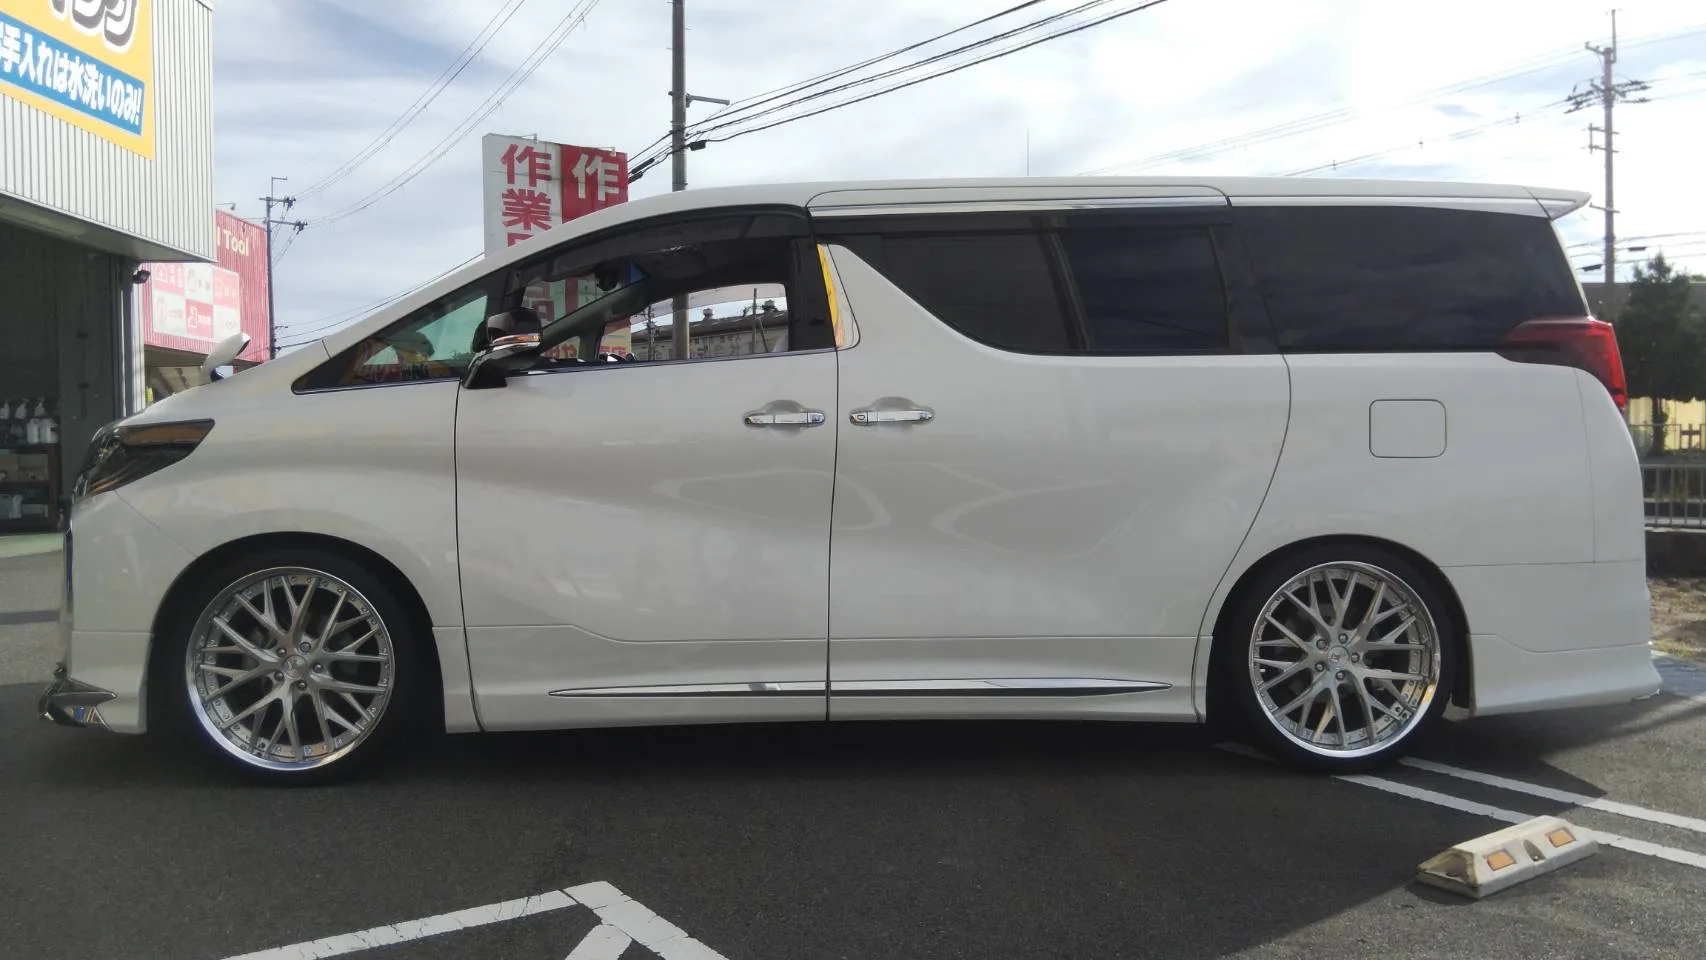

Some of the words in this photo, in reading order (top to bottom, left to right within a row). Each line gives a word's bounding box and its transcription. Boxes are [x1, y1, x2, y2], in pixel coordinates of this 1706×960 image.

[0, 21, 142, 126] 手入れは水洗いのみ!
[223, 229, 249, 257] Tool
